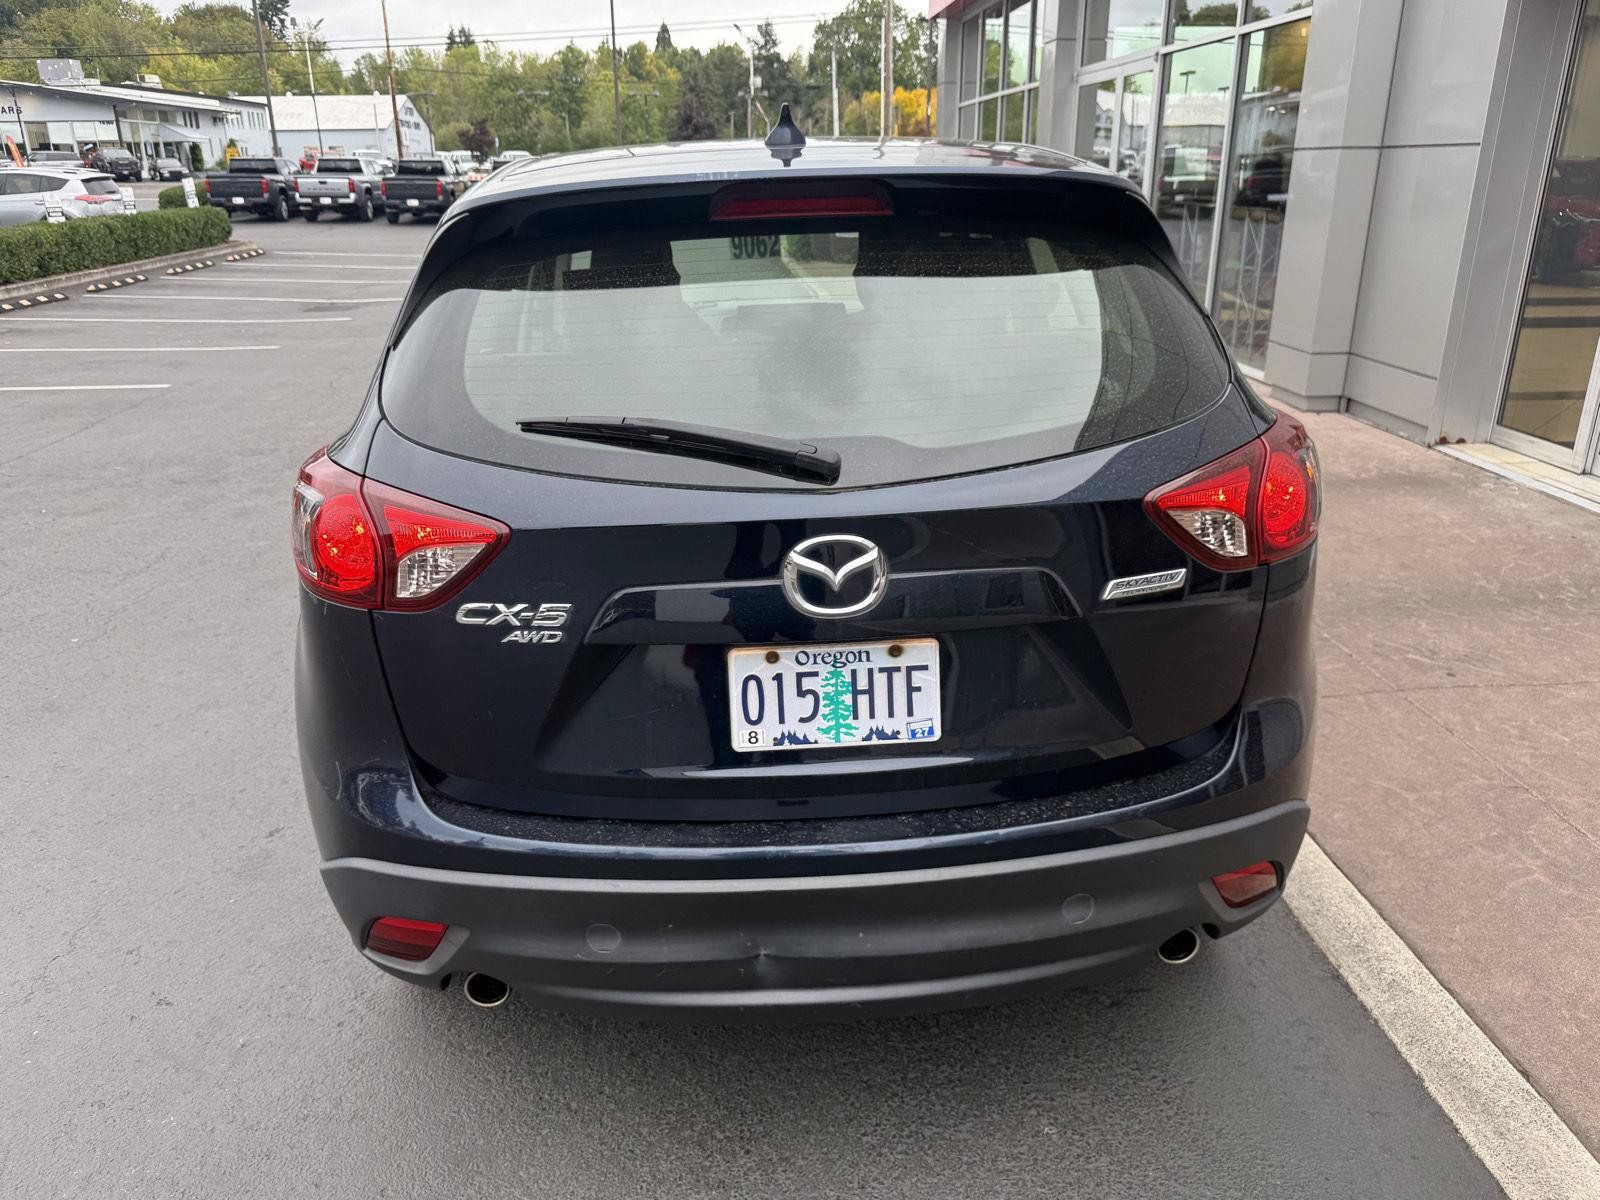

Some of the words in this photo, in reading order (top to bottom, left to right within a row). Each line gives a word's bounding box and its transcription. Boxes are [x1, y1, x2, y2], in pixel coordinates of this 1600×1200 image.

[1115, 572, 1180, 590] SKYACTIV
[455, 602, 573, 627] CX-5
[500, 630, 563, 644] AWD
[794, 649, 873, 669] Oregon
[741, 670, 820, 726] 015
[850, 664, 929, 721] HTF
[748, 730, 759, 745] 8
[914, 728, 930, 739] 27
